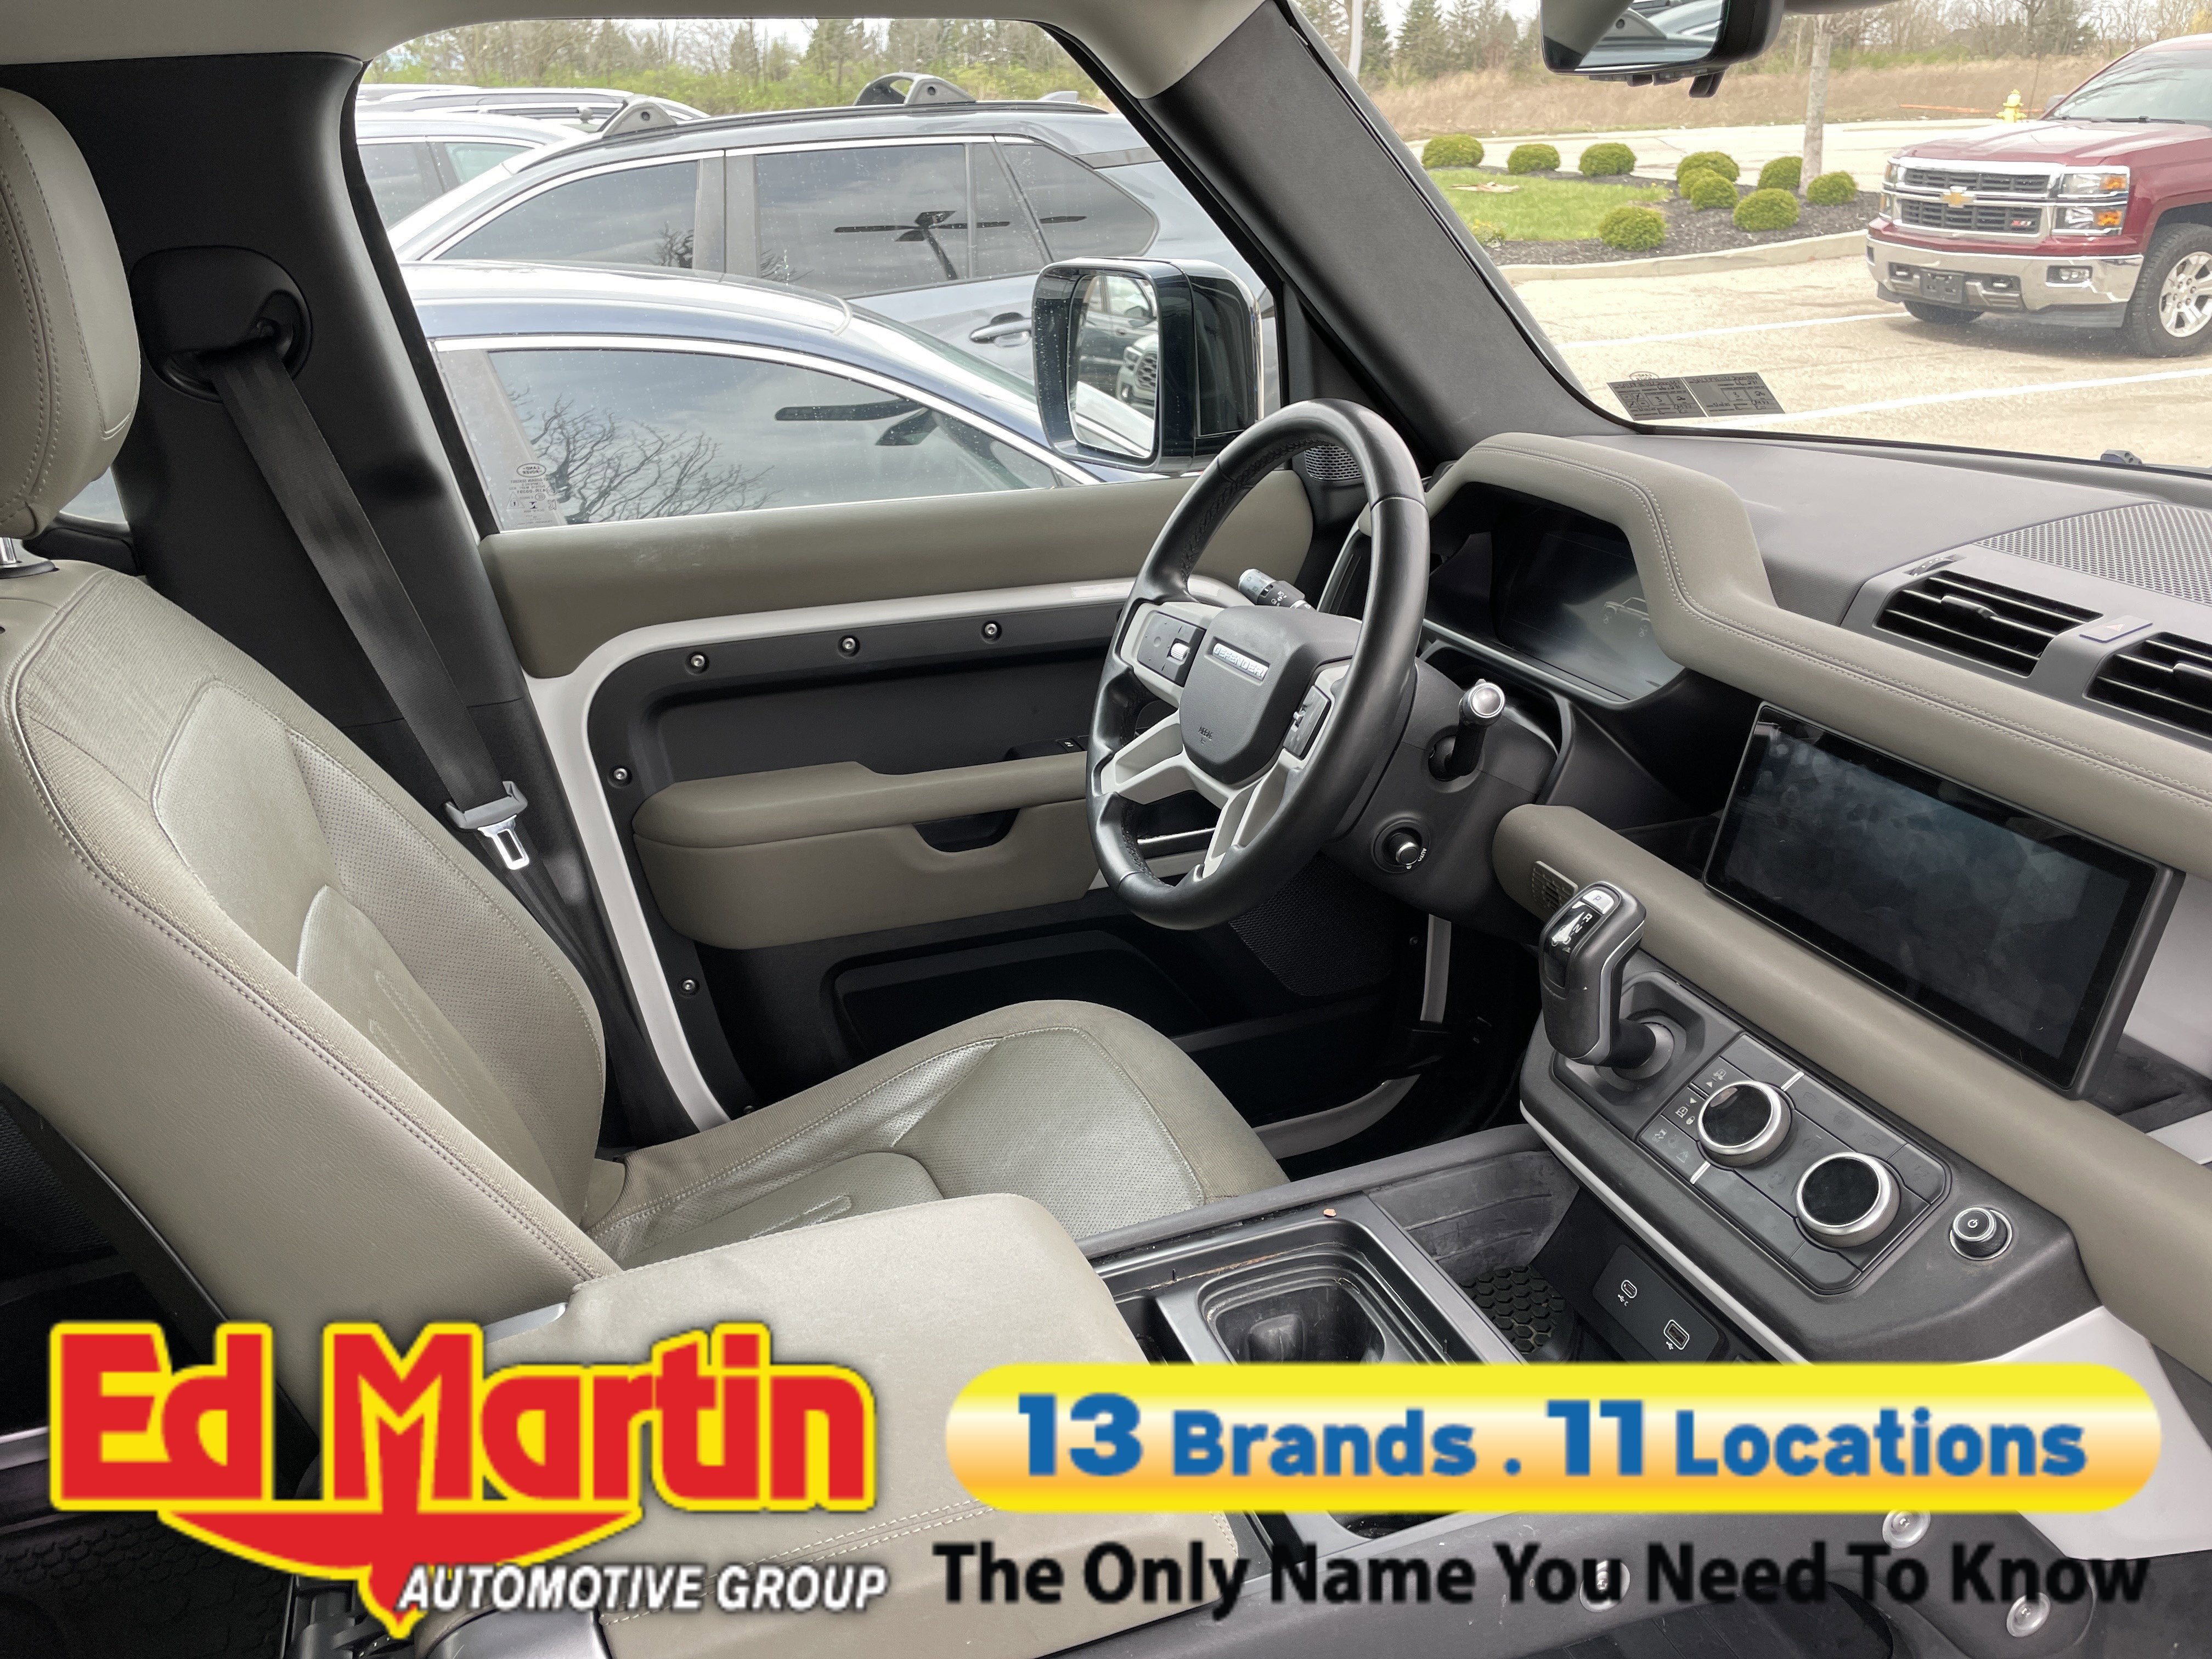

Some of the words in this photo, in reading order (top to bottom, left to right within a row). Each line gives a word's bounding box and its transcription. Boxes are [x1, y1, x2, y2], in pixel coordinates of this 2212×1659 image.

[1213, 646, 1265, 679] DEFENDER
[1582, 913, 1593, 923] R
[1572, 924, 1583, 934] N
